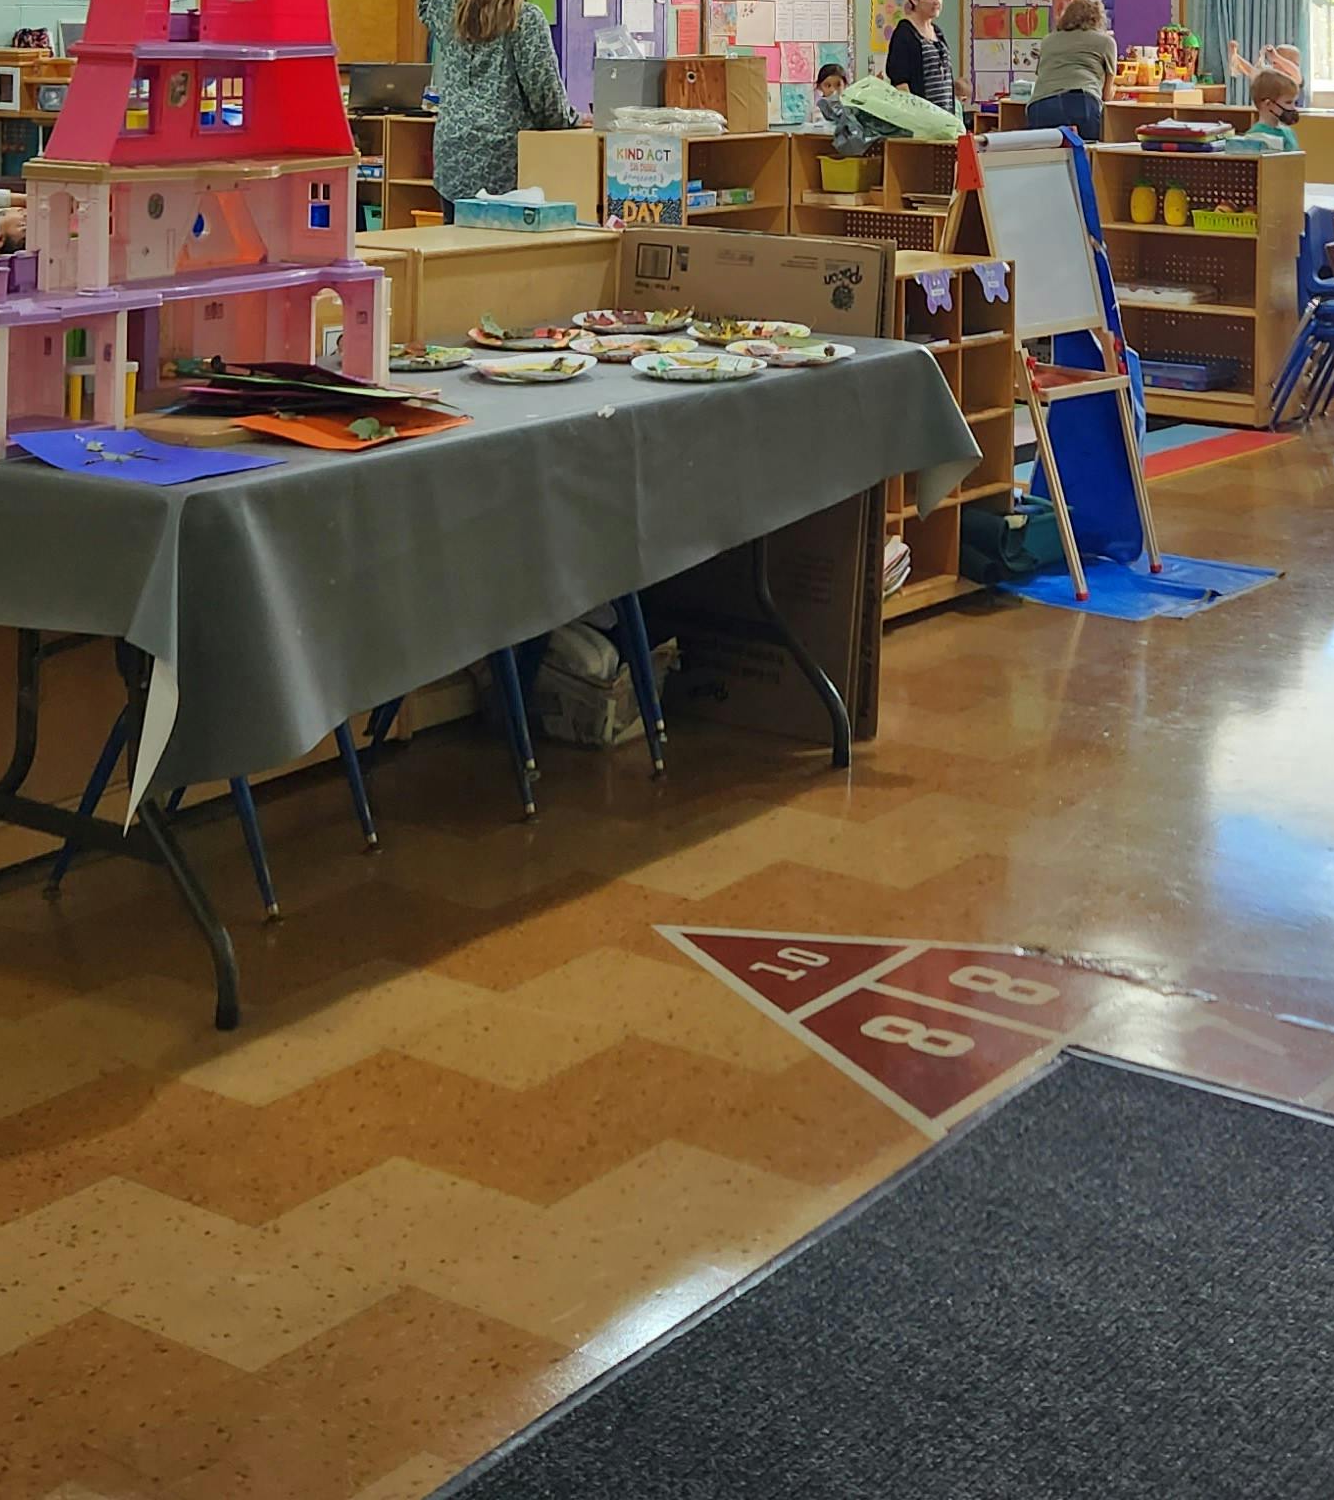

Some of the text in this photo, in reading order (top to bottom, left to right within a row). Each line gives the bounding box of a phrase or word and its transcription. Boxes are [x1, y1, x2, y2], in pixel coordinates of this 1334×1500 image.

[616, 147, 672, 162] KIND ACT
[623, 200, 663, 223] DAY
[948, 965, 1060, 1005] 8
[859, 1014, 975, 1058] 8
